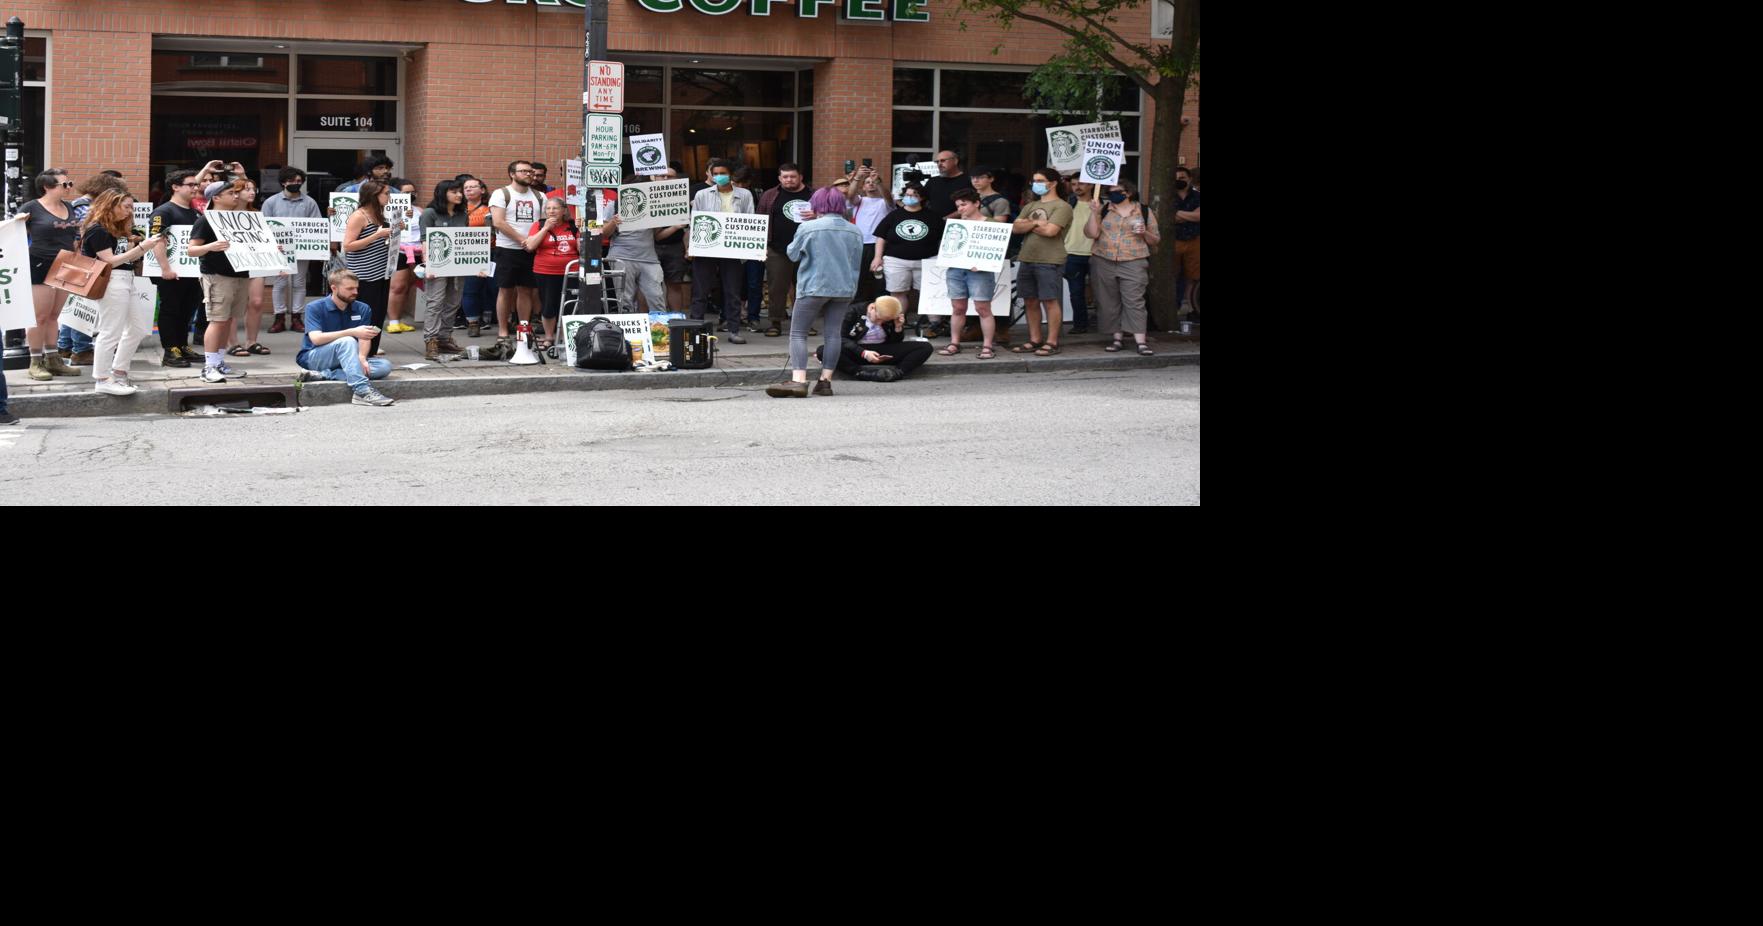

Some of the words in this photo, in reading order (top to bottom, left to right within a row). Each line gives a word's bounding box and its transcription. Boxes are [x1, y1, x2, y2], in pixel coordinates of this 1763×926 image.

[599, 65, 611, 75] NO
[590, 76, 621, 87] STANDING
[320, 116, 351, 126] SUITE
[354, 117, 373, 127] 104
[624, 124, 641, 133] 106
[1080, 125, 1118, 134] STARBUCKS
[591, 134, 617, 142] PARKING
[1081, 132, 1119, 141] CUSTOMER
[591, 142, 617, 150] 9AM-6PM
[1087, 141, 1121, 150] UNION
[593, 150, 615, 158] Mon-Fri
[1086, 148, 1120, 156] STRONG
[649, 182, 687, 192] STARBUCKS
[649, 190, 687, 199] CUSTOMER
[650, 207, 687, 217] UNION
[209, 211, 263, 231] UNION
[725, 217, 767, 225] STARBUCKS
[725, 224, 766, 232] CUSTOMER
[973, 225, 1009, 234] STARBUCKS
[971, 232, 1007, 241] CUSTOMER
[724, 241, 765, 250] UNION
[967, 251, 1002, 260] UNION
[73, 308, 96, 324] UNION
